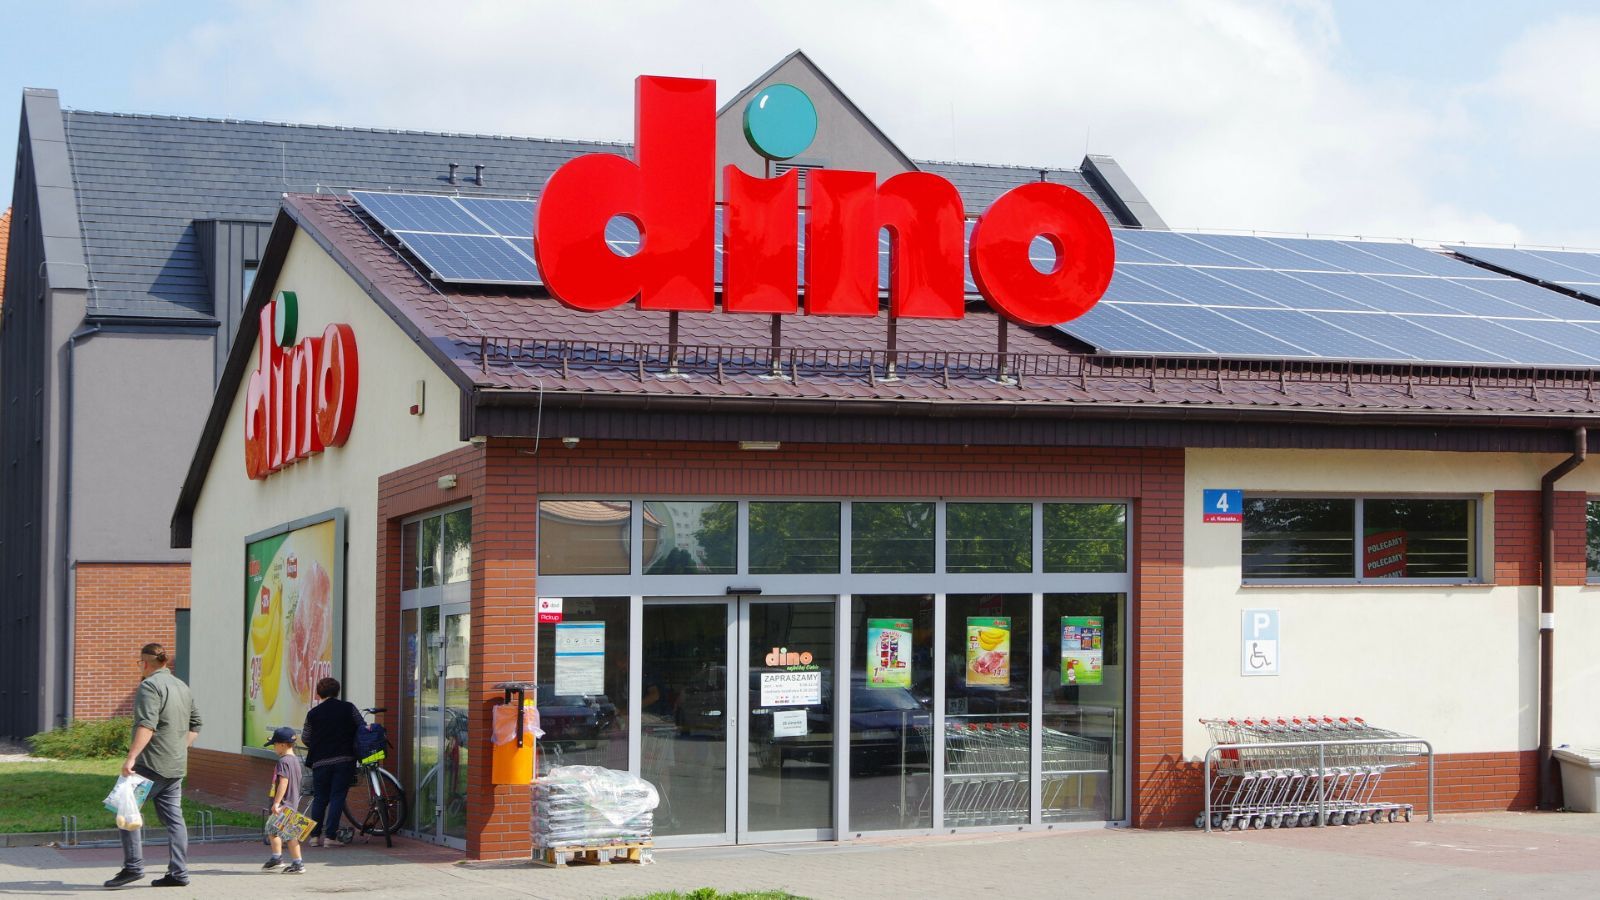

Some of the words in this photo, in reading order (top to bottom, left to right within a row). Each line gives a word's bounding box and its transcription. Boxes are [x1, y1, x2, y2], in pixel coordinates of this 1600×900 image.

[533, 75, 1116, 327] dino
[244, 290, 359, 480] dino
[1216, 492, 1229, 513] 4
[1367, 536, 1403, 554] POLECAMY
[1367, 553, 1403, 571] POLECAMY
[1254, 613, 1270, 638] P
[765, 647, 813, 667] dino
[764, 674, 818, 683] ZAPRASZAMY
